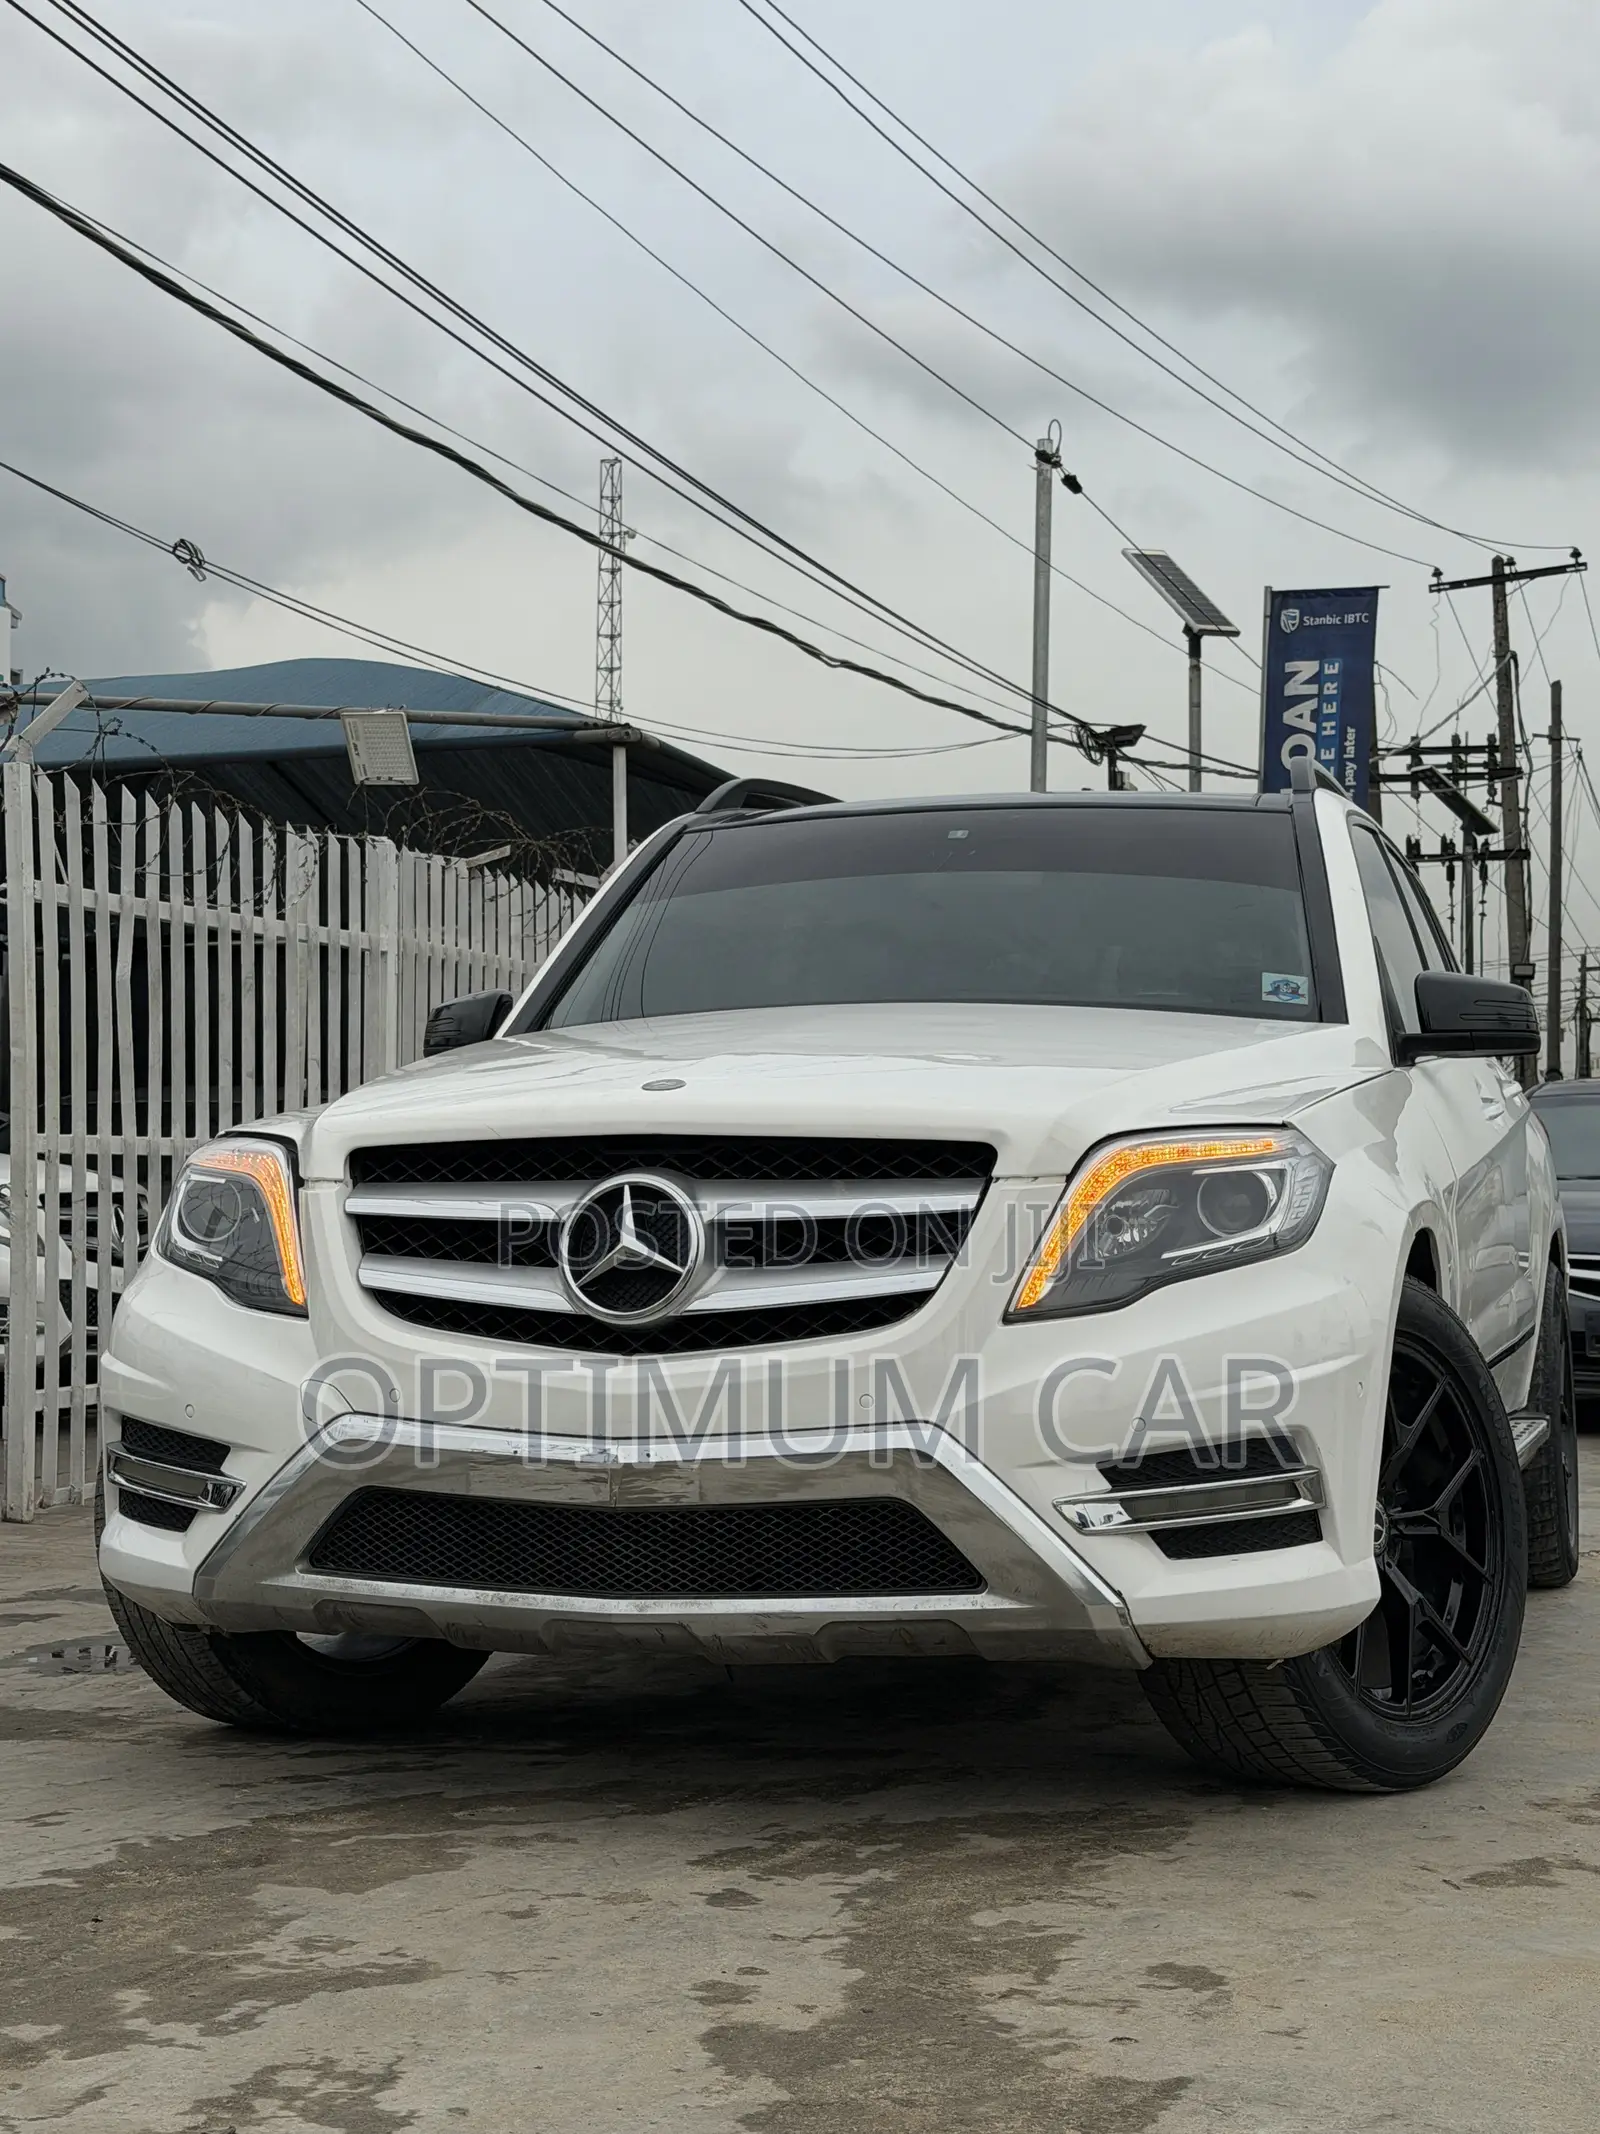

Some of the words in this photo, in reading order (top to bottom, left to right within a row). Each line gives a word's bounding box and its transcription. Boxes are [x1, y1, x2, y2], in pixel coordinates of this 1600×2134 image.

[1302, 613, 1342, 626] Stanbic
[1344, 612, 1369, 624] IBTC
[1321, 662, 1340, 736] HERE
[1280, 660, 1320, 795] OAN
[1343, 726, 1356, 758] later
[1345, 761, 1357, 786] pay
